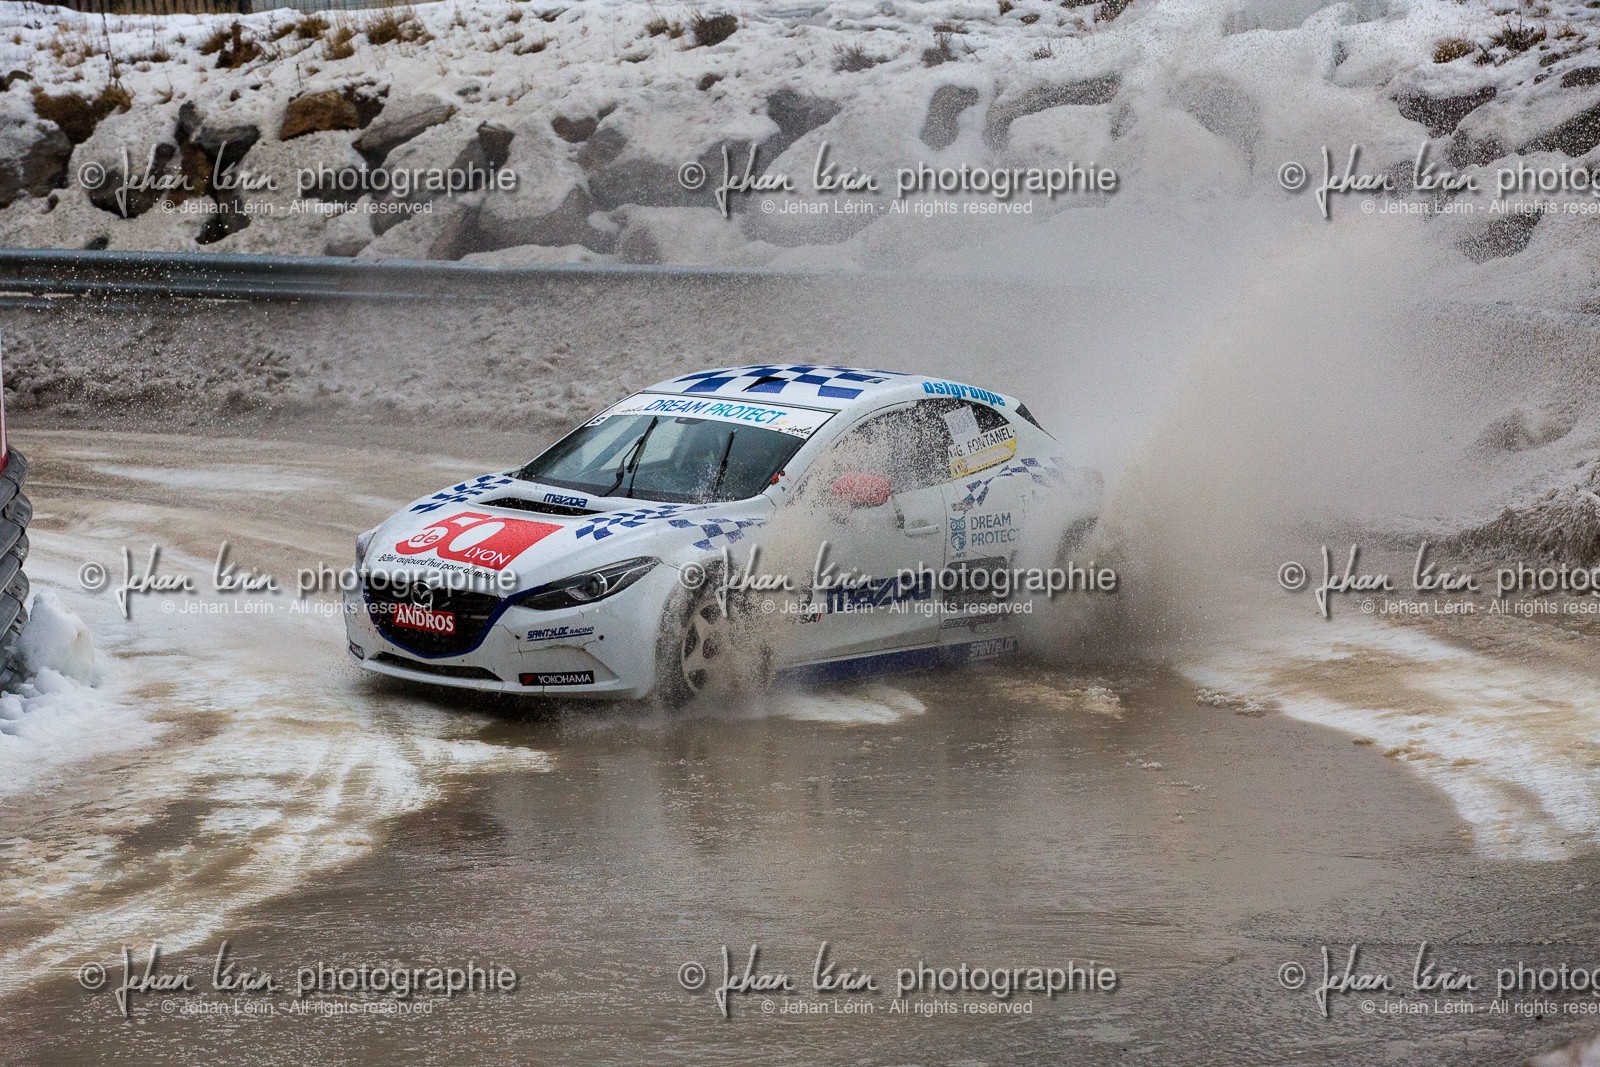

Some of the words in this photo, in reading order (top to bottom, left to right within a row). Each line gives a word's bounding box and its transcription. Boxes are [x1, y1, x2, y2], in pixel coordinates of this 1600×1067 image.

[644, 399, 711, 414] DREAM
[702, 402, 787, 425] PROTECT
[967, 427, 1013, 454] FONTANEL
[543, 493, 588, 508] mazda
[970, 512, 1012, 531] DREAM
[395, 511, 530, 567] 50
[411, 529, 439, 544] de
[464, 546, 511, 565] LYON
[440, 561, 464, 572] pour
[396, 608, 454, 632] ANDROS
[569, 626, 595, 635] RACING
[538, 673, 592, 685] YOKOHAMA
